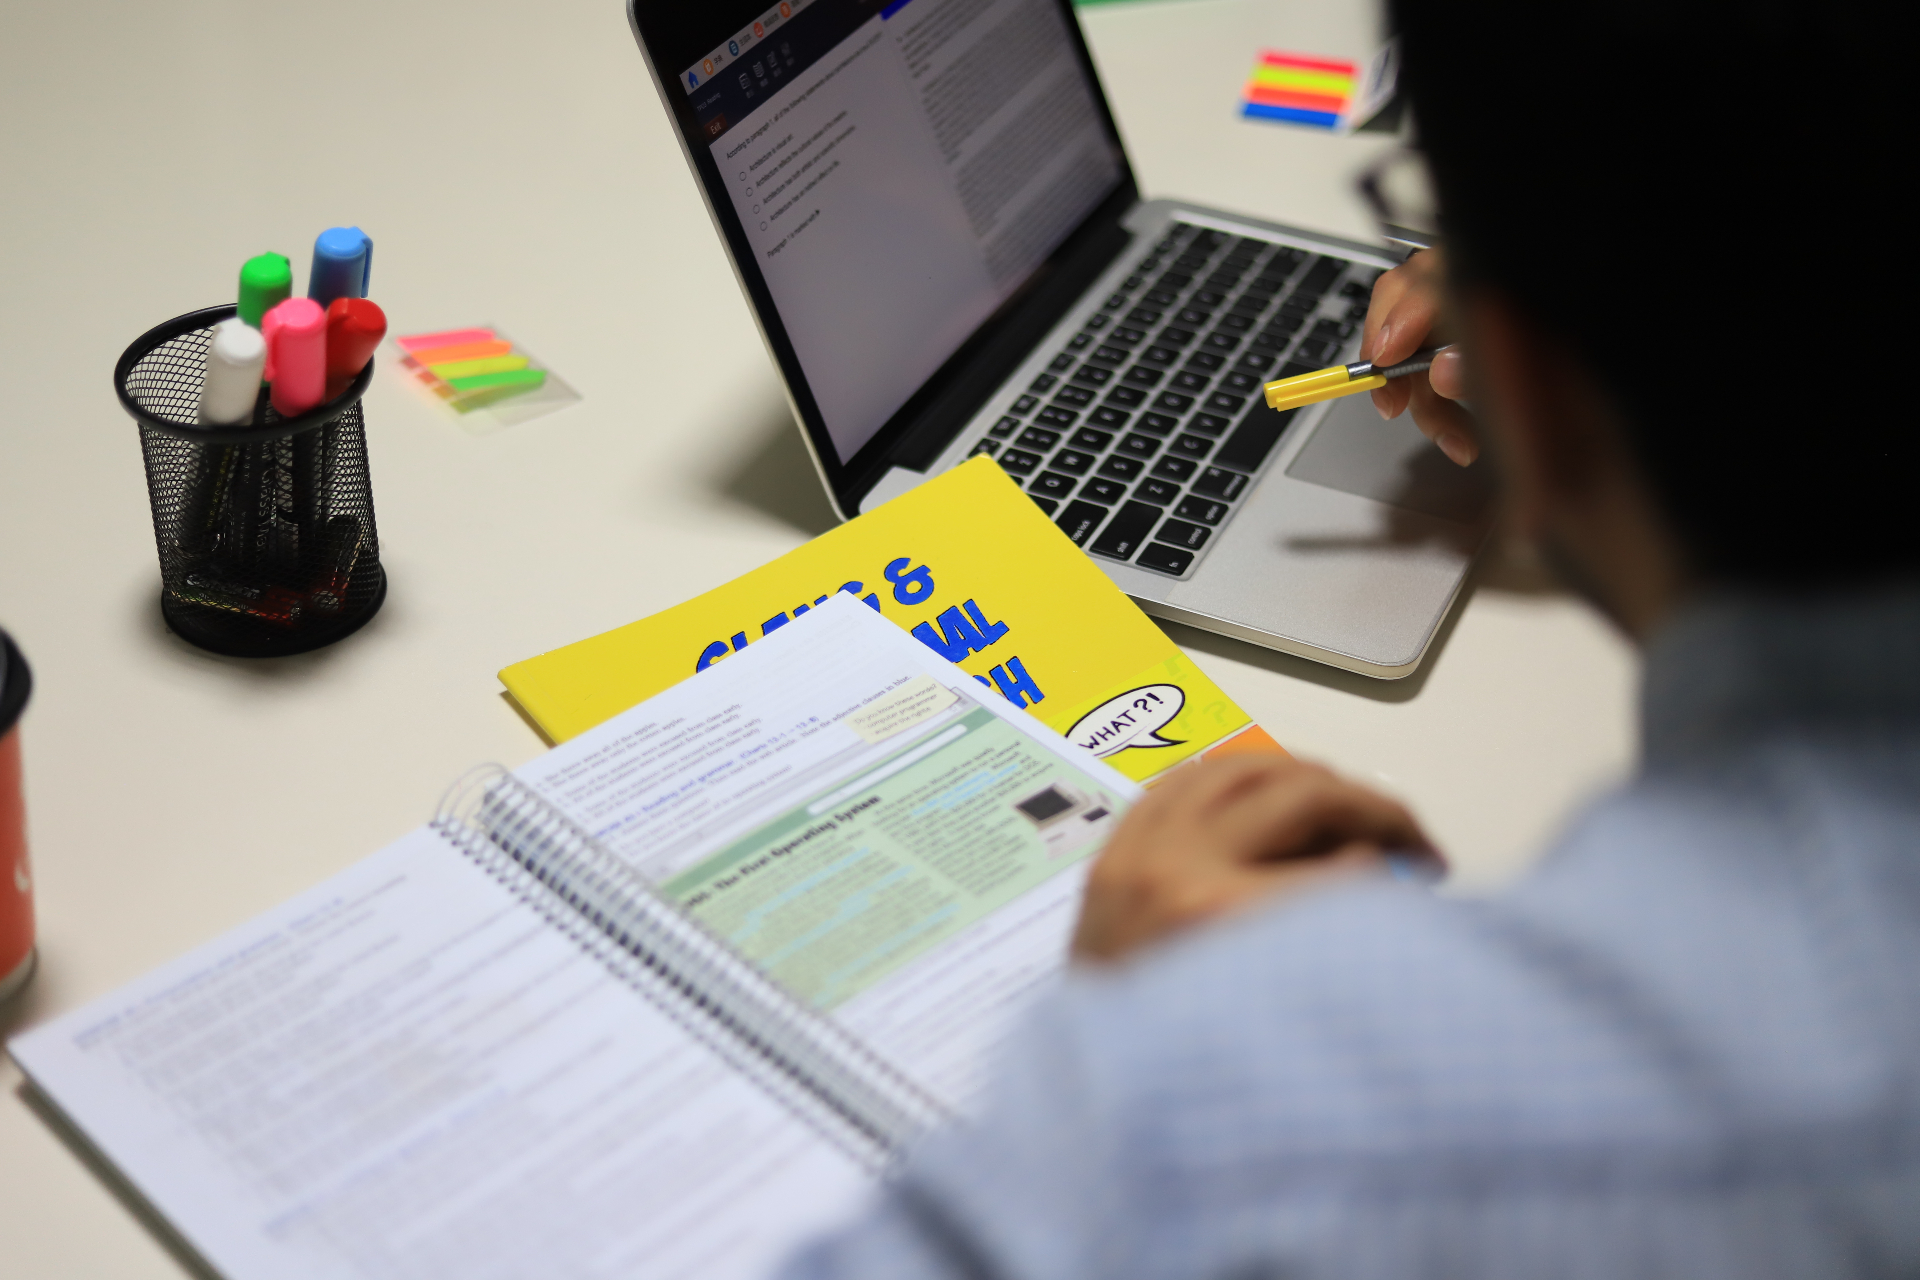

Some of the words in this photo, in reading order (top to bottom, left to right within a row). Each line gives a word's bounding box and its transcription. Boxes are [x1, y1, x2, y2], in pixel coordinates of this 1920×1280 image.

[710, 122, 721, 134] Exit
[726, 142, 747, 159] According
[750, 122, 769, 141] paragraph
[884, 557, 935, 605] &
[893, 676, 911, 686] blue.
[915, 683, 938, 698] words?
[771, 821, 837, 857] Operating
[835, 797, 880, 822] System
